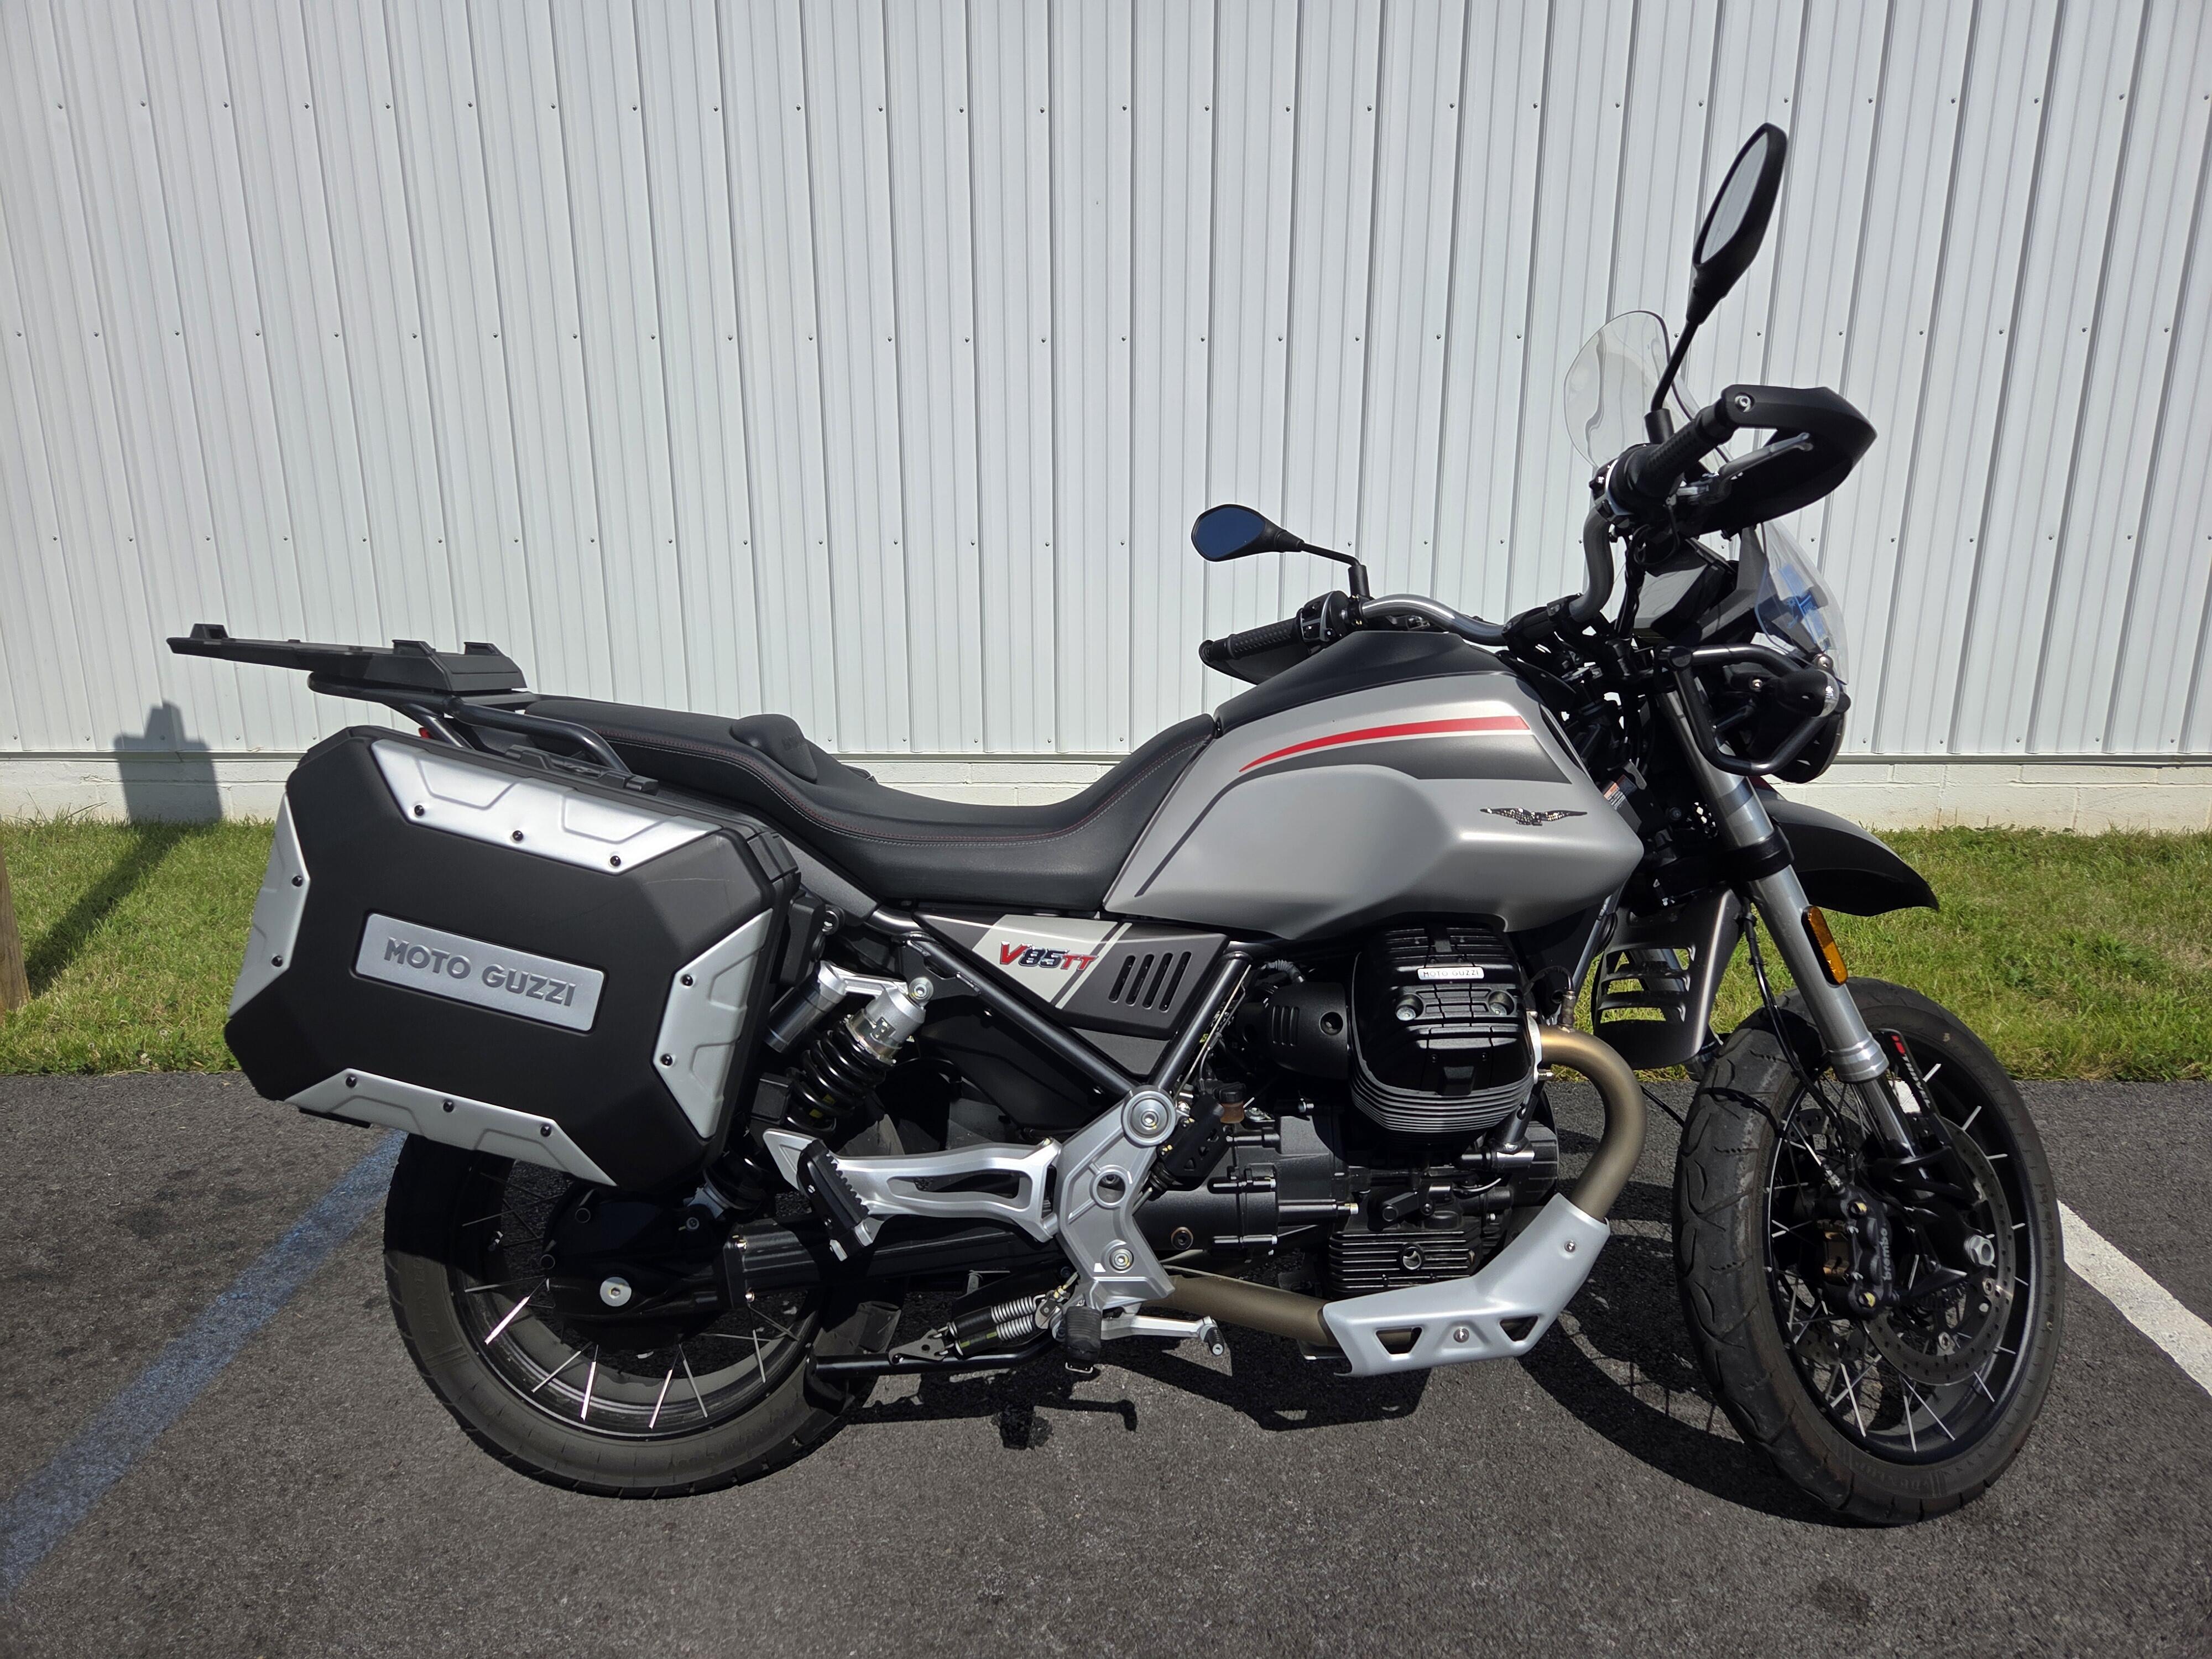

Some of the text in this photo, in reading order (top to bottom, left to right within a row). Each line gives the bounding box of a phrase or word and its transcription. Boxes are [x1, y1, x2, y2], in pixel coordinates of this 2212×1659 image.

[384, 936, 577, 1007] MOTO GUZZI
[1000, 941, 1099, 971] V85TT
[1880, 1227, 1892, 1281] brembo
